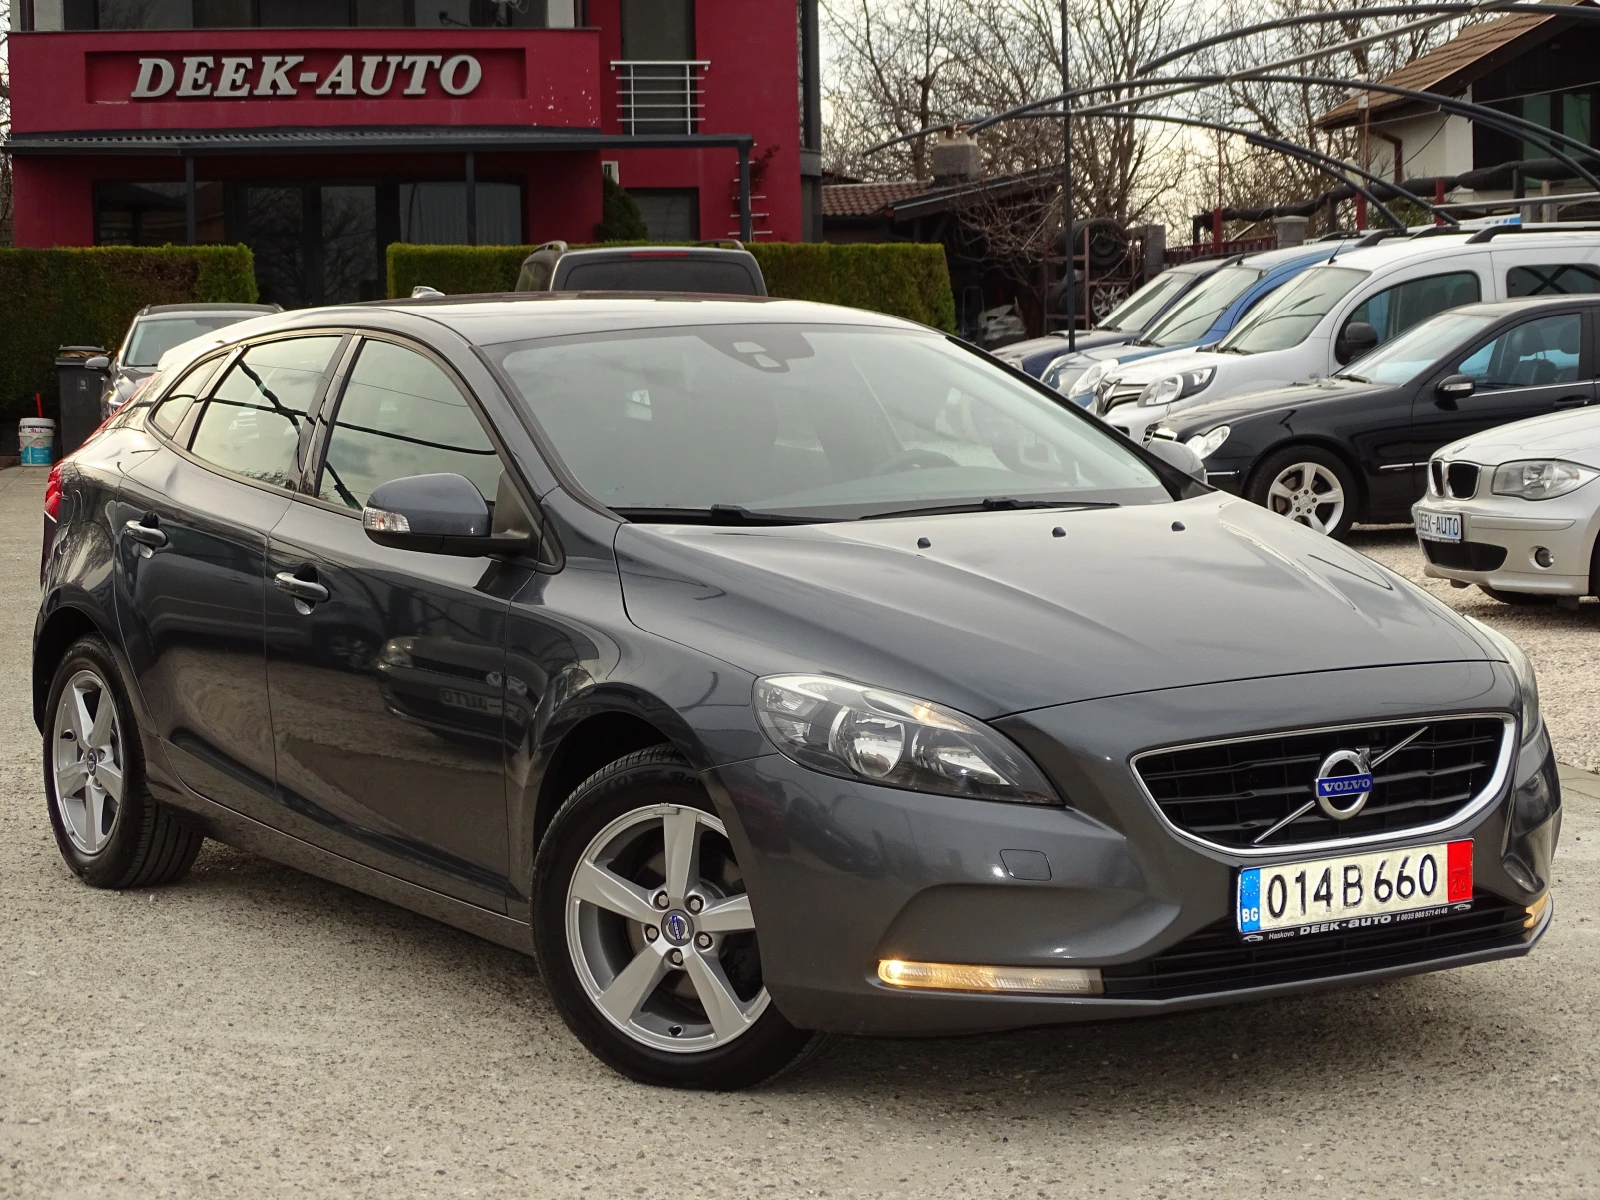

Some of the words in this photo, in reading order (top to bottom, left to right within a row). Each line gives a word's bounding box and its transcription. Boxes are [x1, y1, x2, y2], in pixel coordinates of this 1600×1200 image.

[130, 54, 483, 98] DEEK-AUTO
[1322, 779, 1371, 792] VOLVO
[1241, 907, 1259, 923] BG
[1268, 931, 1295, 940] Haskovo
